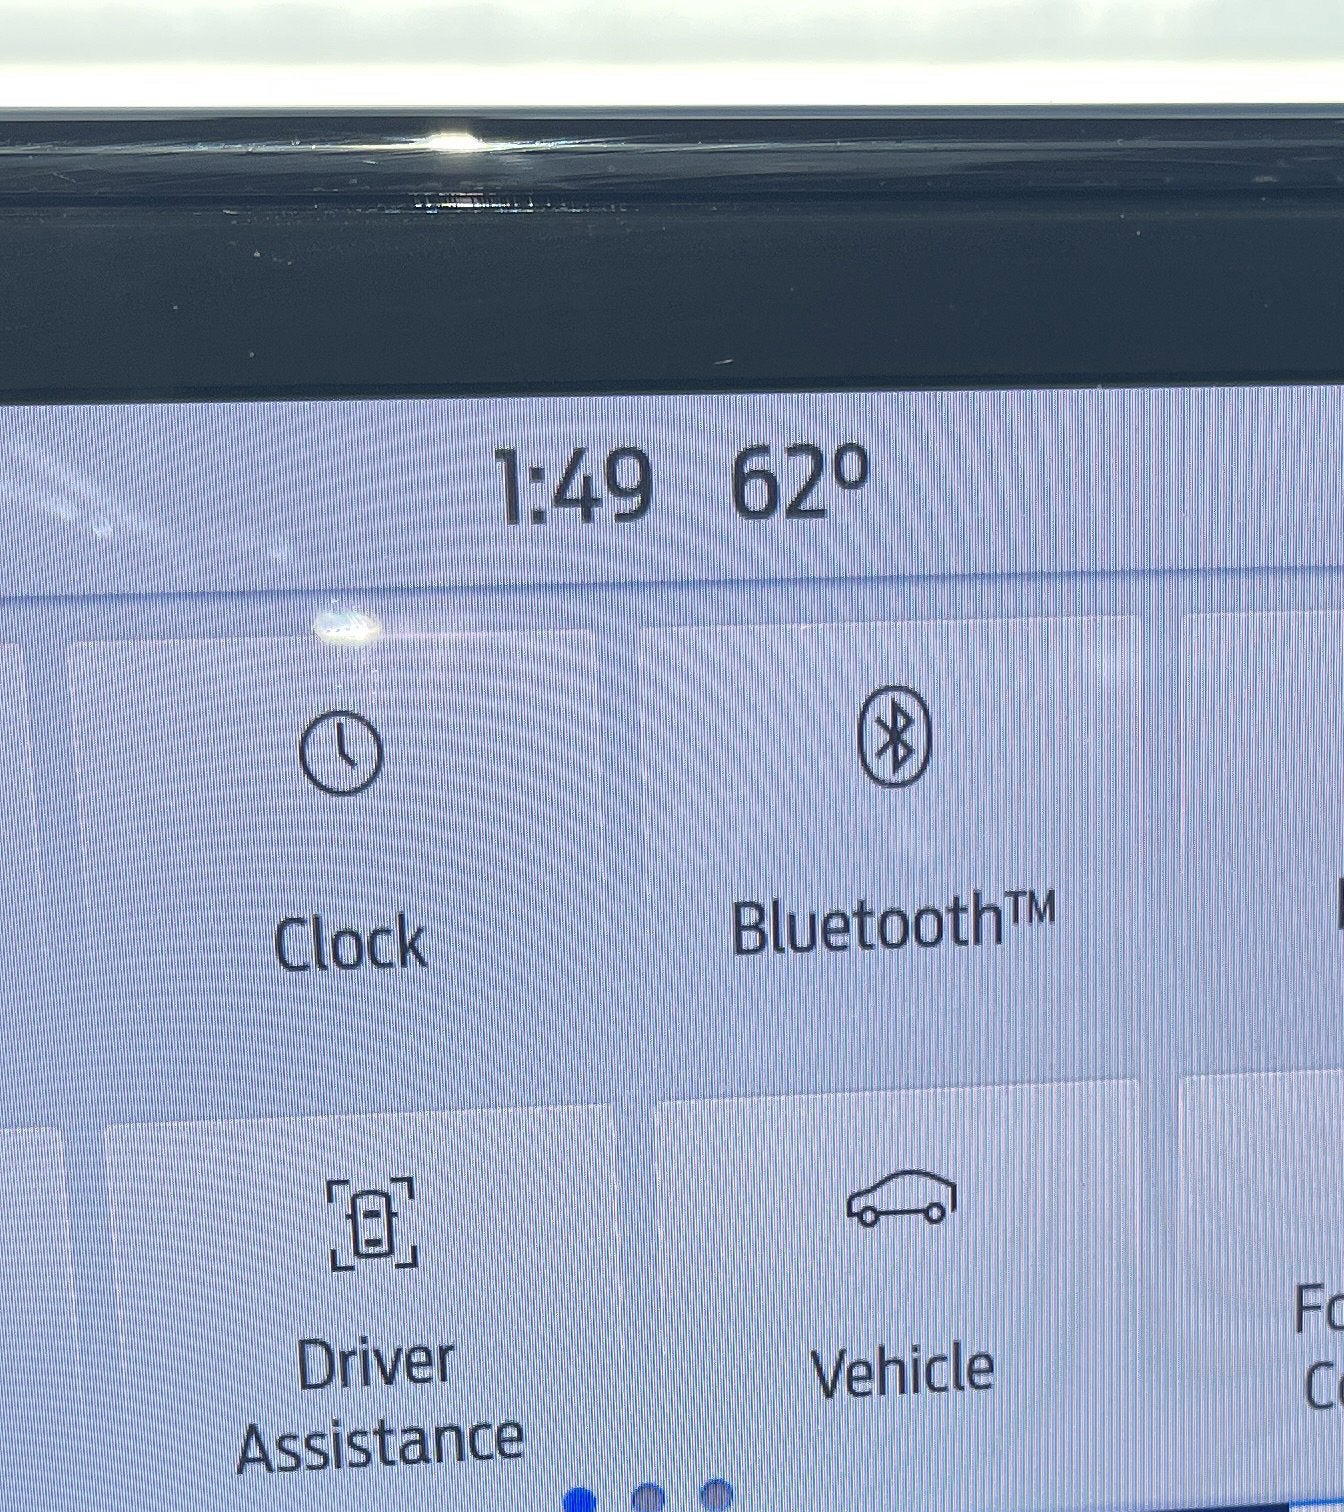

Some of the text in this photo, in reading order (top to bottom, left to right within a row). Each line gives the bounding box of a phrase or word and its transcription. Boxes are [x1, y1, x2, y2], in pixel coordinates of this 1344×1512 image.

[494, 445, 654, 526] 1:49
[273, 910, 430, 974] Clock
[297, 1335, 455, 1392] Driver
[809, 1340, 996, 1401] Vehicle
[236, 1419, 526, 1475] Assistance
